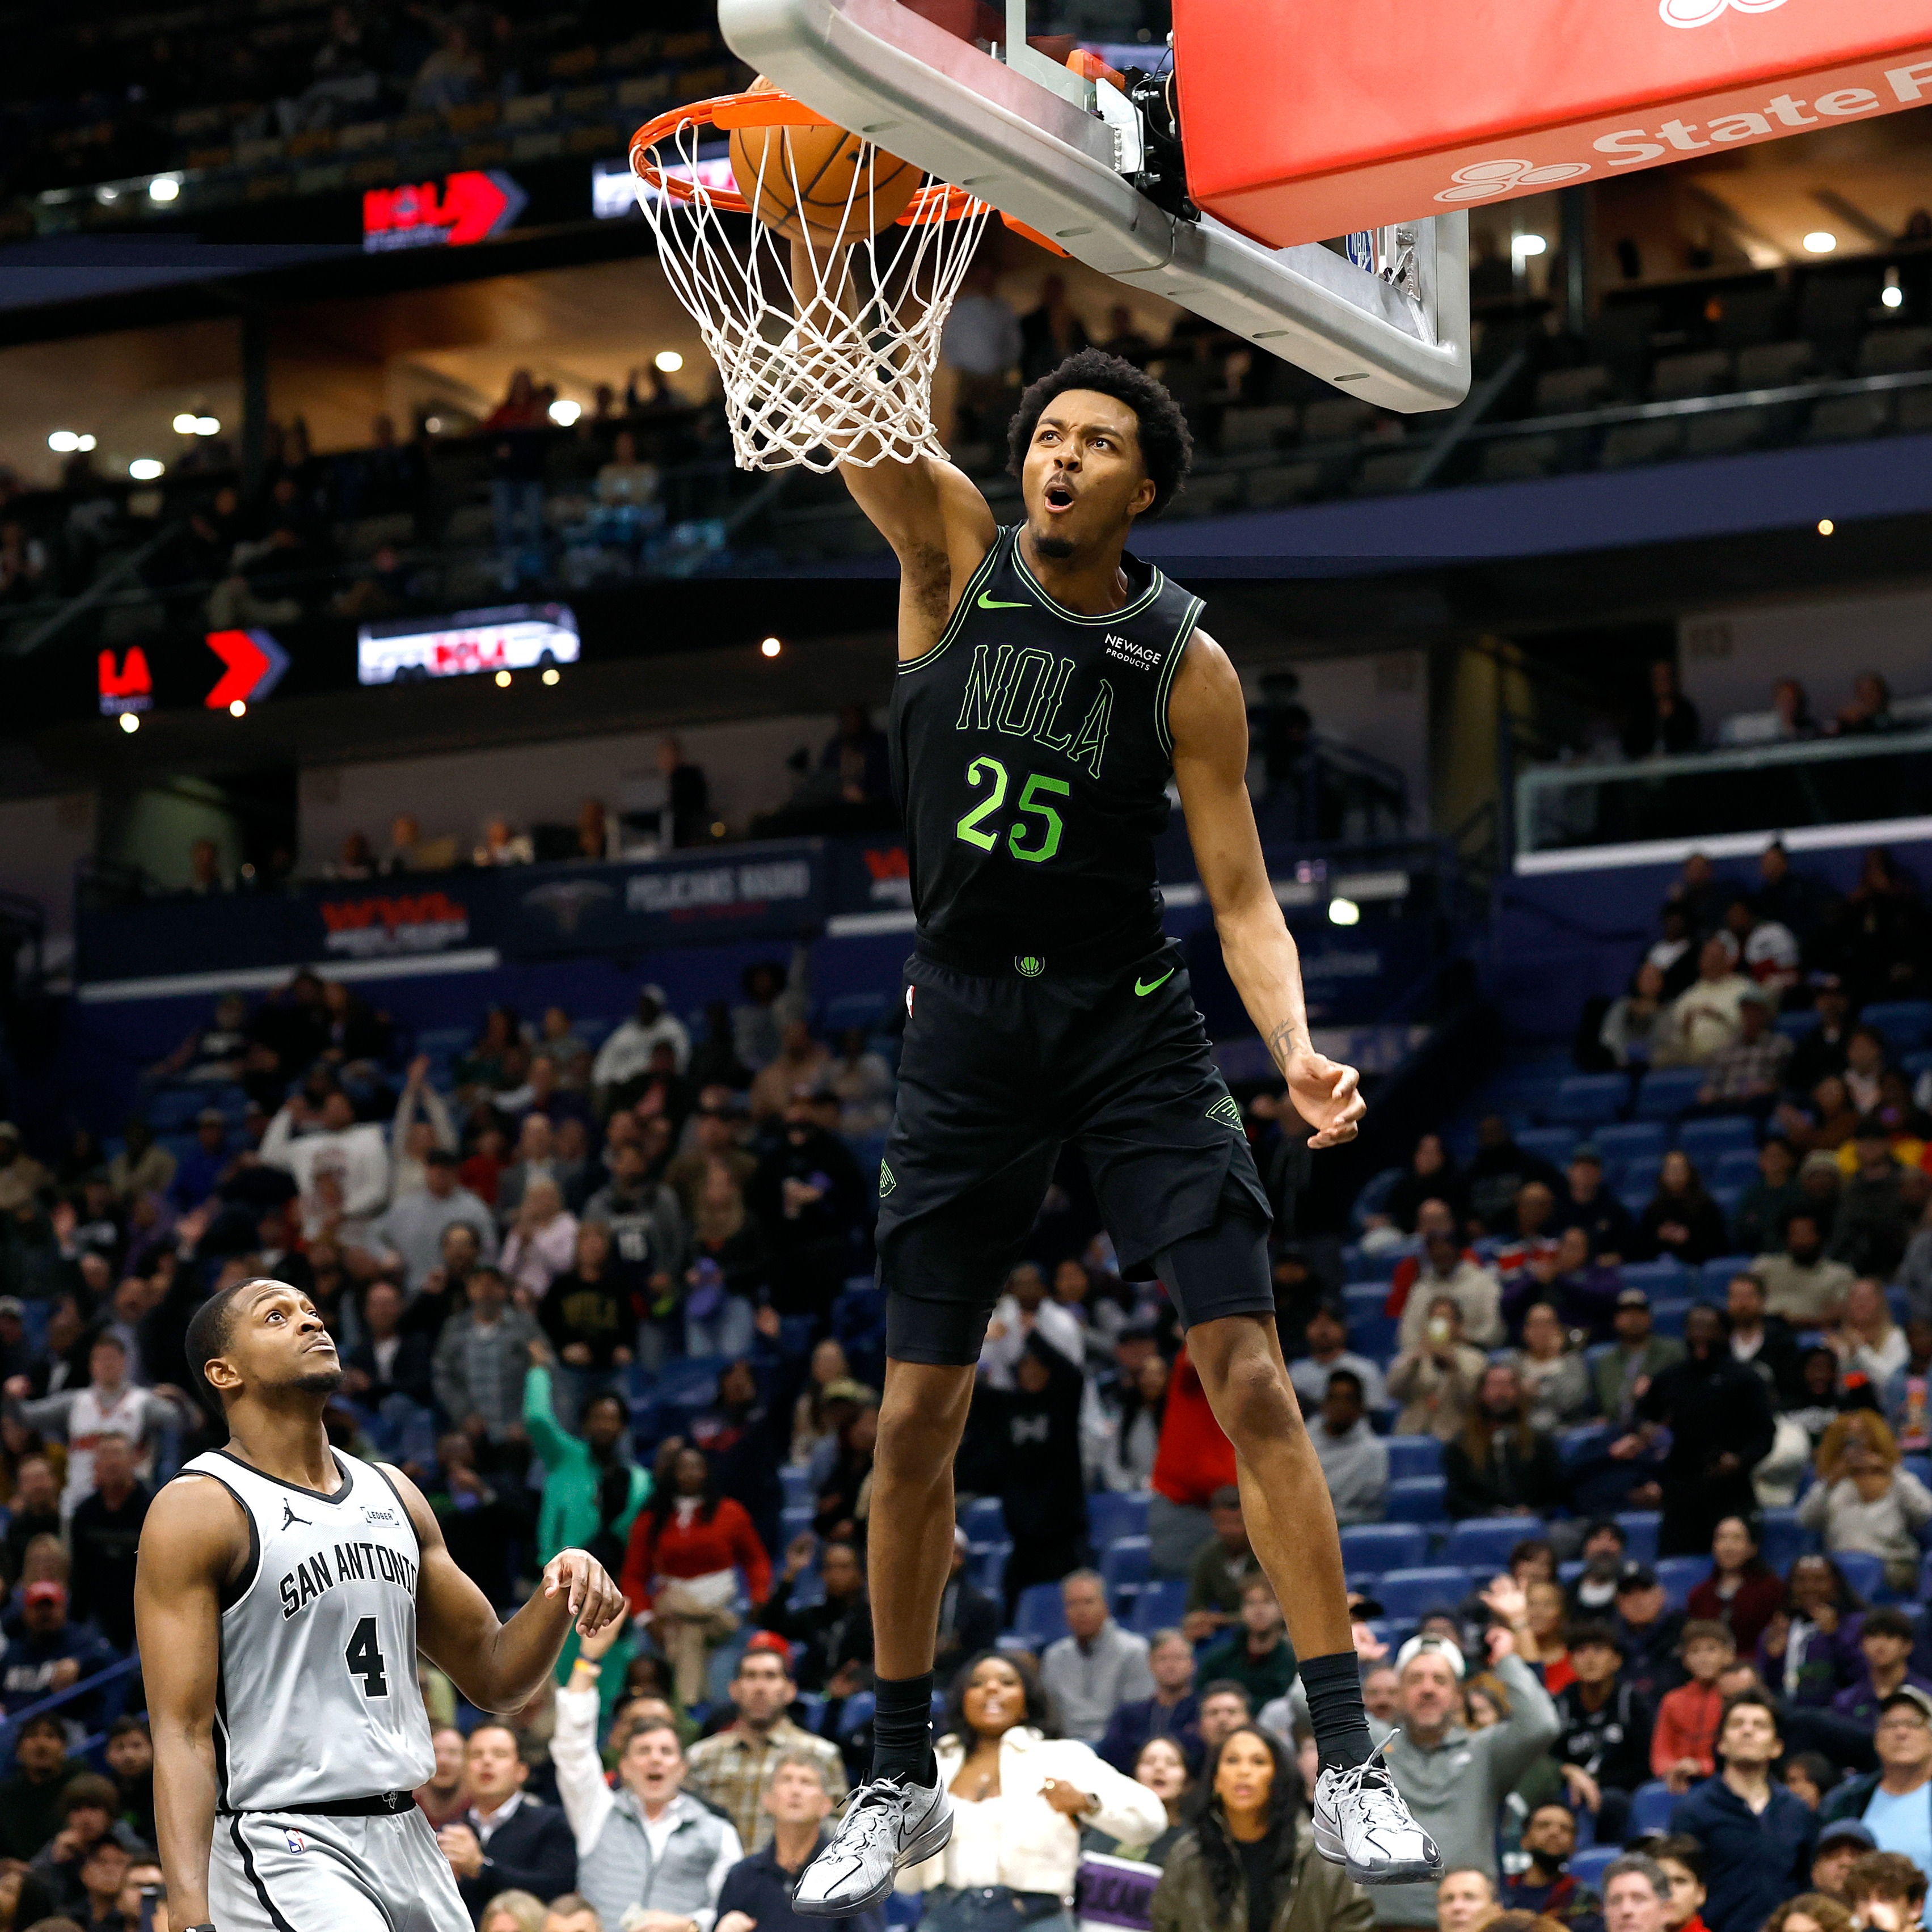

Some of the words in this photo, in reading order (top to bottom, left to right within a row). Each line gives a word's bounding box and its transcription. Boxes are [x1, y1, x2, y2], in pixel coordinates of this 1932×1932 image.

[1593, 88, 1879, 166] State
[1351, 231, 1367, 261] NBA
[1104, 632, 1162, 665] NEWAGE
[1106, 648, 1150, 671] PRODUCTS
[956, 644, 1113, 779] NOLA
[955, 755, 1070, 863] 25
[367, 1511, 393, 1520] LEDGER
[279, 1551, 335, 1621] SAN
[344, 1615, 390, 1699] 4
